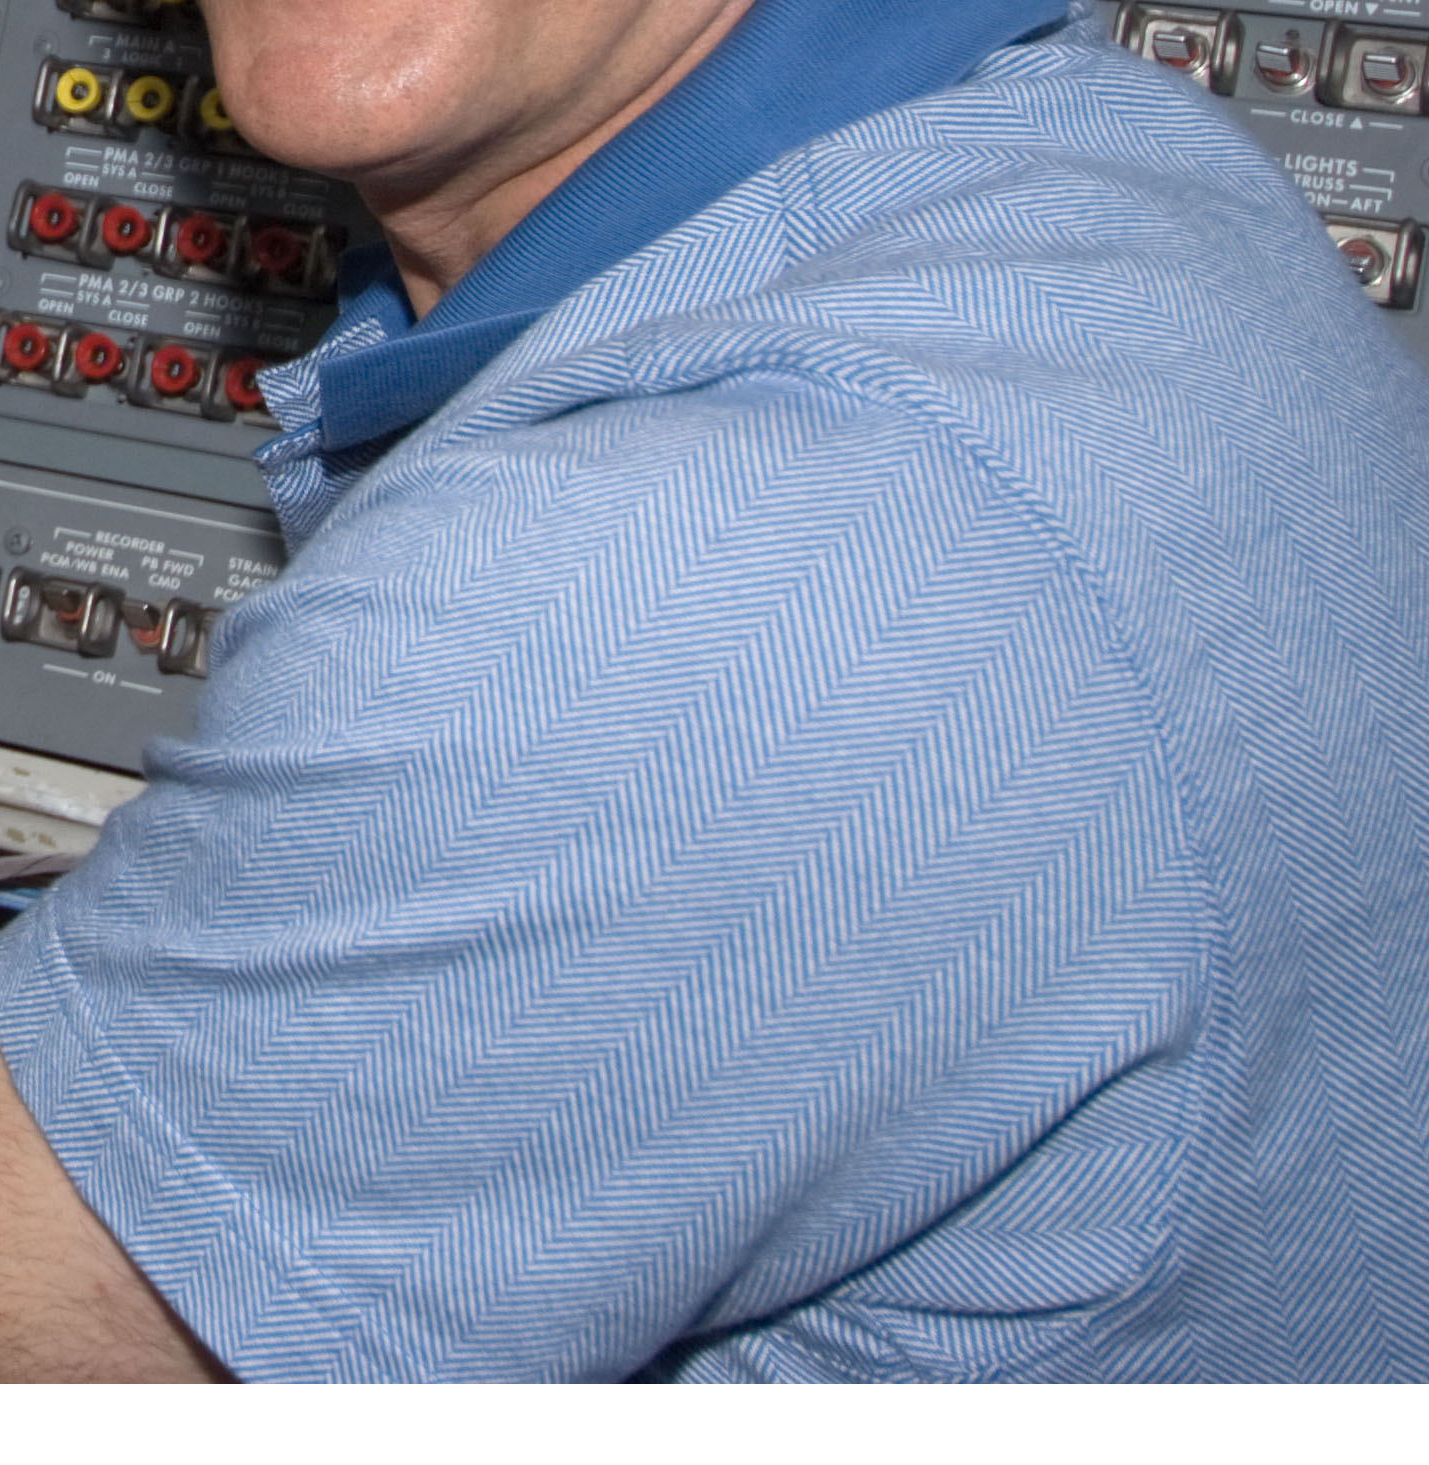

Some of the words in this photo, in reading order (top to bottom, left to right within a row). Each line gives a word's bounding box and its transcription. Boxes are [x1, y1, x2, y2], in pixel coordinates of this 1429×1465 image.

[1289, 108, 1346, 128] CLOSE
[101, 162, 126, 178] SYS
[126, 166, 138, 181] A
[103, 145, 140, 166] PMA
[144, 152, 175, 170] 2/3
[178, 156, 213, 176] GRP
[228, 162, 291, 184] HOOKS
[1283, 152, 1359, 178] LIGHTS
[63, 171, 101, 188] OPEN
[133, 180, 175, 198] CLOSE
[1292, 172, 1346, 192] TRUSS
[208, 191, 249, 209] OPEN
[1349, 197, 1385, 214] AFT
[76, 271, 115, 293] PMA
[118, 279, 149, 299] 2/3
[151, 284, 186, 307] GRP
[189, 290, 200, 306] 2
[202, 290, 266, 317] HOOKS
[76, 289, 101, 305] SYS
[100, 293, 113, 307] A
[37, 298, 75, 316] OPEN
[107, 307, 150, 327] CLOSE
[183, 320, 222, 339] OPEN
[65, 540, 116, 562] POWER
[95, 529, 166, 555] RECORDER
[40, 551, 98, 574] PCM/WB
[101, 562, 130, 581] ENA
[141, 554, 160, 572] PB
[162, 559, 196, 578] FWD
[228, 556, 278, 577] STRAIN
[147, 572, 182, 591] CMD
[92, 669, 117, 686] ON
